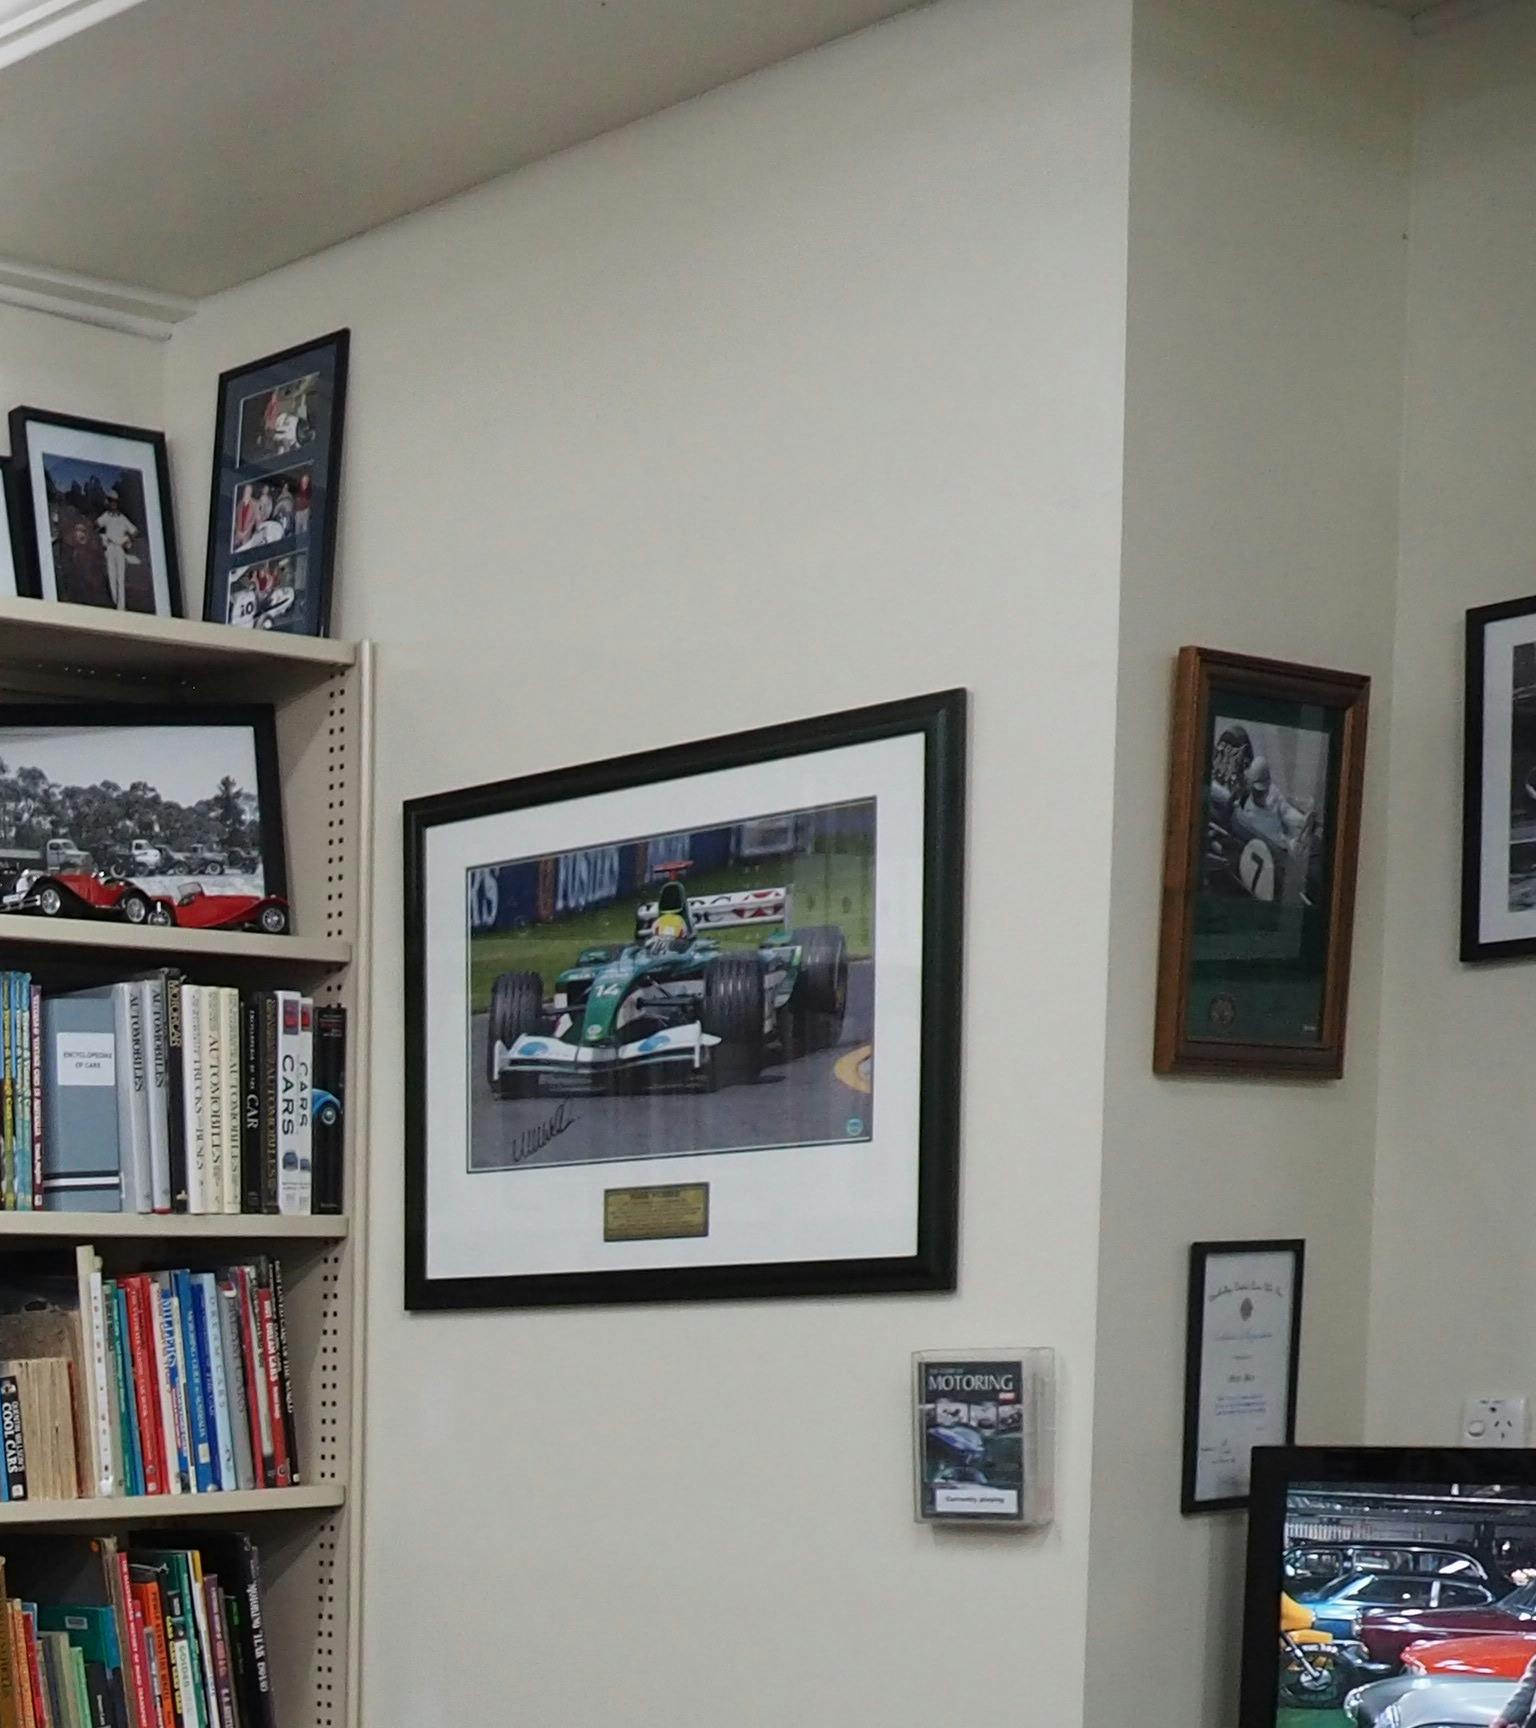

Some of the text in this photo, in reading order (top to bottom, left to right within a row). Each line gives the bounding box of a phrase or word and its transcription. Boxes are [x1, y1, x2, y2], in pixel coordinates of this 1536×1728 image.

[595, 985, 619, 997] 14
[129, 993, 144, 1092] AUTOMOBILES
[152, 990, 165, 1088] AUTOMOBILES
[208, 1035, 221, 1164] AUTOMOBILES
[246, 1094, 259, 1129] CAR
[282, 1054, 295, 1135] CARS
[299, 1062, 308, 1127] CARS
[928, 1374, 1014, 1391] MOTORING
[1, 1402, 17, 1474] COOL CARS
